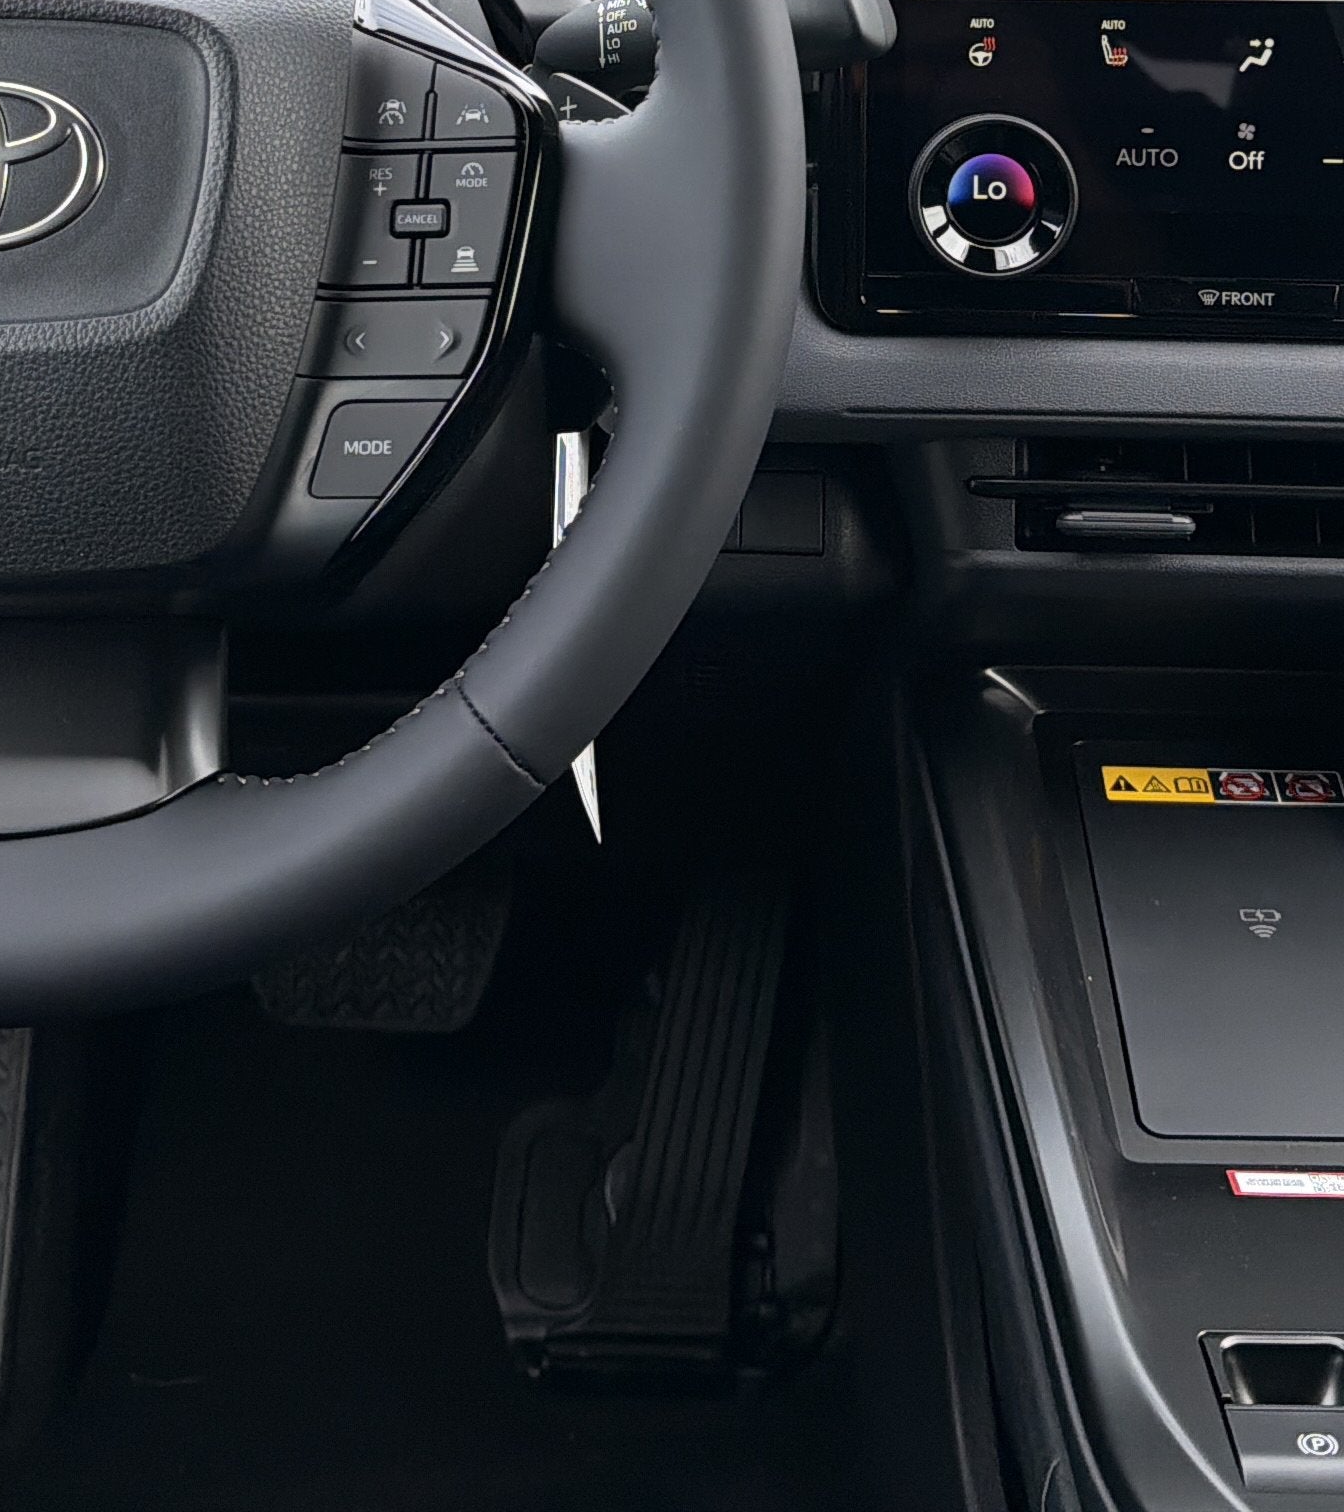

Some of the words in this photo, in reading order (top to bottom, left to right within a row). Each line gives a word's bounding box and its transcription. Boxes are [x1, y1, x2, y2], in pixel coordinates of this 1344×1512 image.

[606, 9, 627, 22] OFF
[607, 19, 637, 35] AUTO
[969, 18, 995, 29] AUTO
[1101, 20, 1126, 31] AUTO
[606, 38, 621, 50] LO
[608, 53, 621, 64] HI
[1115, 147, 1179, 168] AUTO
[1228, 150, 1265, 170] Off
[369, 168, 393, 181] RES
[455, 176, 488, 189] MODE
[973, 175, 1007, 200] Lo
[397, 214, 439, 225] CANCEL
[1221, 290, 1275, 307] FRONT
[343, 439, 392, 456] MODE
